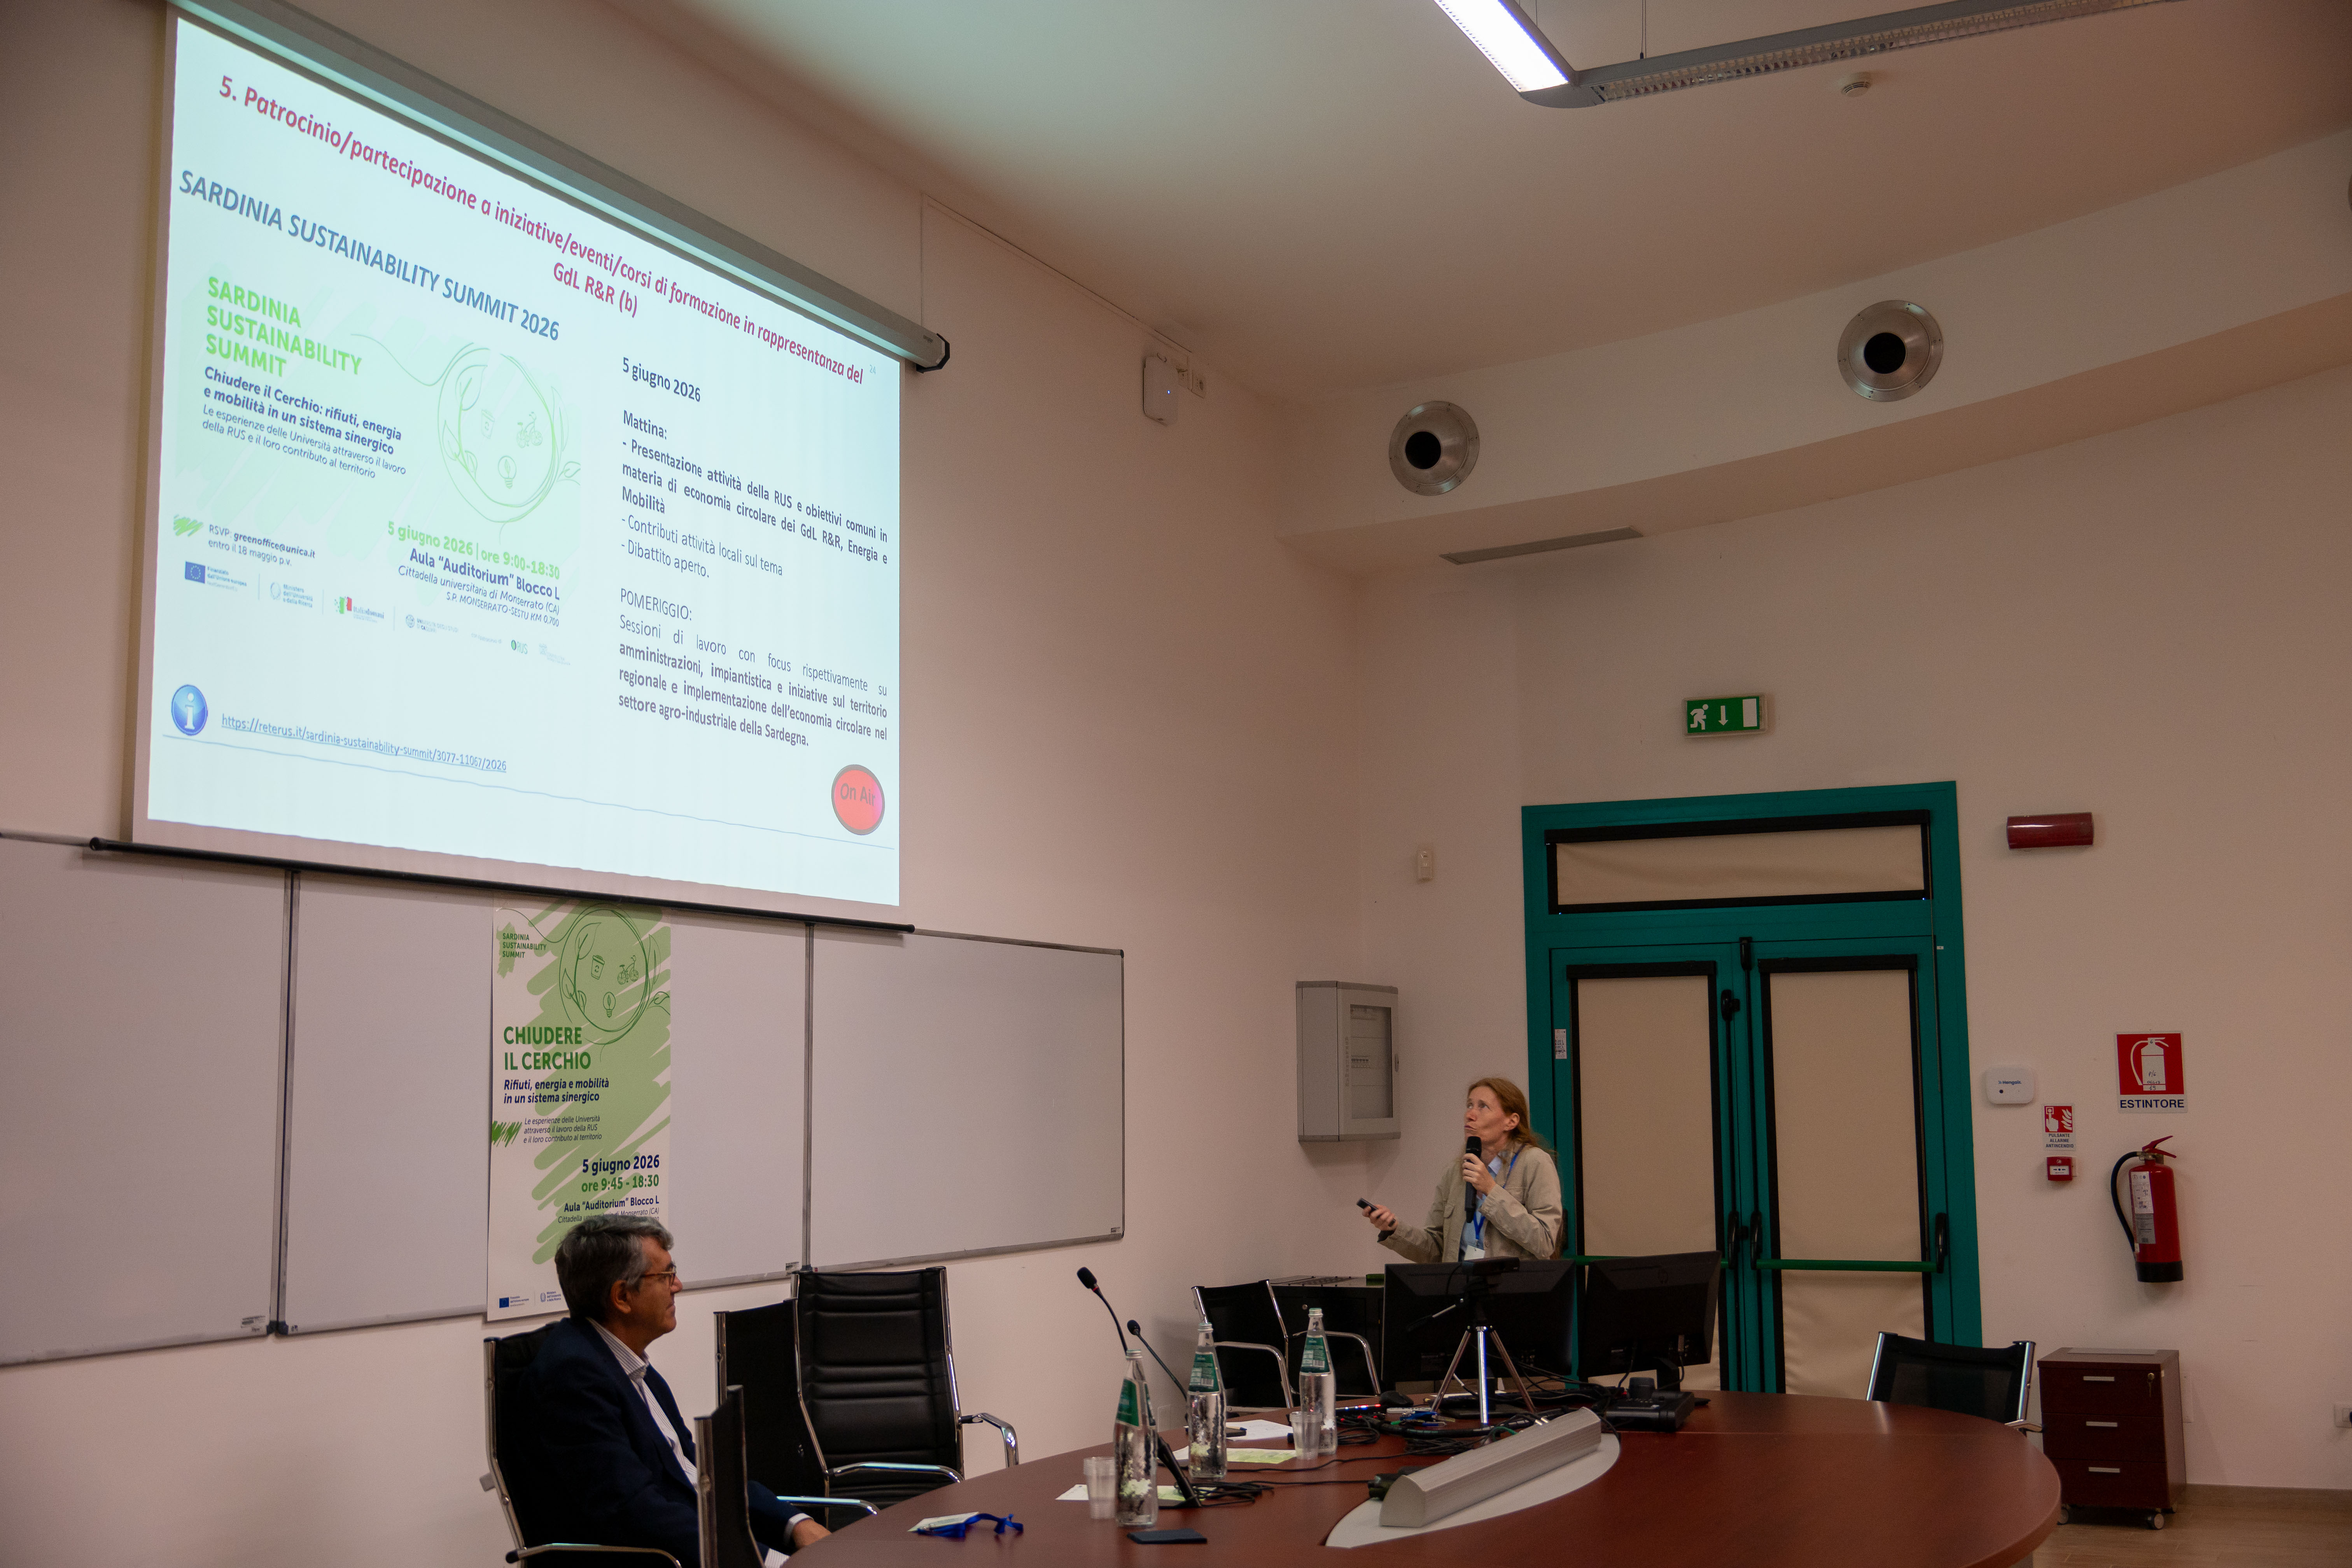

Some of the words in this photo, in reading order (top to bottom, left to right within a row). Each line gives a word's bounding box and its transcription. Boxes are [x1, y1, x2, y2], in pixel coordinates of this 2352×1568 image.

[179, 170, 282, 231] SARDINIA
[288, 214, 440, 292] SUSTAINABILITY
[442, 278, 519, 323] SUMMIT
[520, 309, 559, 341] 2026
[244, 86, 477, 209] Patrocinio/partecipazione
[495, 200, 652, 289] iniziative/eventi/corsi
[668, 281, 740, 329] formazione
[757, 326, 844, 376] rappresentanza
[847, 364, 863, 384] del
[208, 276, 301, 328] SARDINIA
[553, 262, 579, 290] GdL
[584, 275, 614, 304] R&R
[619, 289, 637, 318] (b)
[206, 333, 287, 377] SUMMIT
[207, 304, 362, 375] SUSTAINABILITY
[632, 363, 670, 390] giugno
[673, 379, 700, 402] 2026
[869, 364, 876, 375] 24
[205, 366, 261, 395] Chiudere
[274, 388, 323, 415] Cerchio:
[325, 406, 359, 428] rifiuti,
[362, 420, 401, 440] energia
[214, 390, 265, 415] mobilità
[299, 416, 342, 438] sistema
[345, 430, 394, 455] sinergico
[216, 410, 265, 432] esperienze
[266, 424, 287, 439] delle
[289, 430, 331, 452] Università
[332, 446, 374, 464] attraverso
[382, 458, 406, 475] lavoro
[623, 410, 667, 440] Mattina:
[202, 419, 224, 434] della
[227, 425, 246, 440] RUS
[263, 436, 280, 451] loro
[282, 444, 327, 465] contributo
[339, 460, 375, 478] territorio
[622, 486, 665, 514] Mobilità
[632, 439, 702, 477] Presentazione
[707, 469, 741, 491] attività
[747, 481, 769, 500] della
[774, 490, 792, 508] RUS
[806, 503, 841, 527] obiettivi
[846, 519, 876, 539] comuni
[622, 464, 662, 487] materia
[684, 486, 730, 511] economia
[736, 502, 776, 526] circolare
[781, 516, 795, 533] dei
[800, 523, 817, 541] GdL
[822, 530, 843, 551] R&R,
[848, 539, 877, 562] Energia
[208, 539, 230, 551] entro
[238, 544, 247, 555] 18
[249, 549, 277, 563] maggio
[233, 532, 315, 558] greenoffice@unica.it
[397, 525, 440, 548] giugno
[443, 536, 473, 556] 2026
[481, 550, 500, 564] ore
[503, 551, 560, 580] 9:00-18:30
[628, 514, 677, 544] Contributi
[681, 534, 715, 555] attività
[719, 542, 742, 563] locali
[745, 554, 757, 568] sul
[760, 557, 782, 576] tema
[628, 539, 671, 566] Dibattito
[674, 558, 709, 578] aperto.
[398, 565, 438, 584] Cittadella
[440, 578, 487, 597] universitaria
[499, 590, 544, 610] Monserrato
[546, 601, 559, 616] (CA)
[410, 548, 434, 568] Aula
[516, 576, 552, 597] Blocco
[459, 594, 529, 620] MONSERRATO-SESTU
[530, 612, 542, 622] KM
[621, 588, 691, 621] POMERIGGIO:
[620, 614, 660, 639] Sessioni
[696, 634, 726, 655] lavoro
[738, 649, 755, 663] con
[768, 653, 791, 672] focus
[803, 663, 868, 691] rispettivamente
[620, 643, 703, 678] amministrazioni,
[711, 662, 771, 690] impiantistica
[789, 681, 827, 704] iniziative
[833, 694, 844, 708] sul
[850, 698, 887, 718] territorio
[618, 695, 656, 713] settore
[659, 704, 737, 731] agro-industriale
[740, 718, 762, 736] della
[765, 724, 808, 746] Sardegna.
[619, 668, 667, 691] regionale
[684, 680, 766, 713] implementazione
[836, 717, 871, 737] circolare
[875, 727, 887, 740] nel
[840, 783, 856, 800] On
[859, 786, 875, 806] Air
[502, 942, 546, 950] SUSTAINABILITY
[503, 1026, 582, 1045] CHIUDERE
[504, 1052, 518, 1070] IL
[522, 1051, 591, 1070] CERCHIO
[504, 1079, 532, 1091] Rifiuti,
[535, 1078, 567, 1092] energia
[575, 1078, 609, 1088] mobilità
[527, 1093, 560, 1103] sistema
[562, 1091, 600, 1104] sinergico
[2120, 1099, 2184, 1108] ESTINTORE
[532, 1117, 560, 1127] esperienze
[575, 1115, 600, 1124] Università
[581, 1182, 598, 1192] ore
[601, 1177, 623, 1192] 9:45
[632, 1174, 659, 1188] 18:30
[592, 1158, 631, 1176] giugno
[633, 1154, 660, 1169] 2026
[564, 1202, 580, 1212] Aula
[630, 1197, 654, 1206] Blocco
